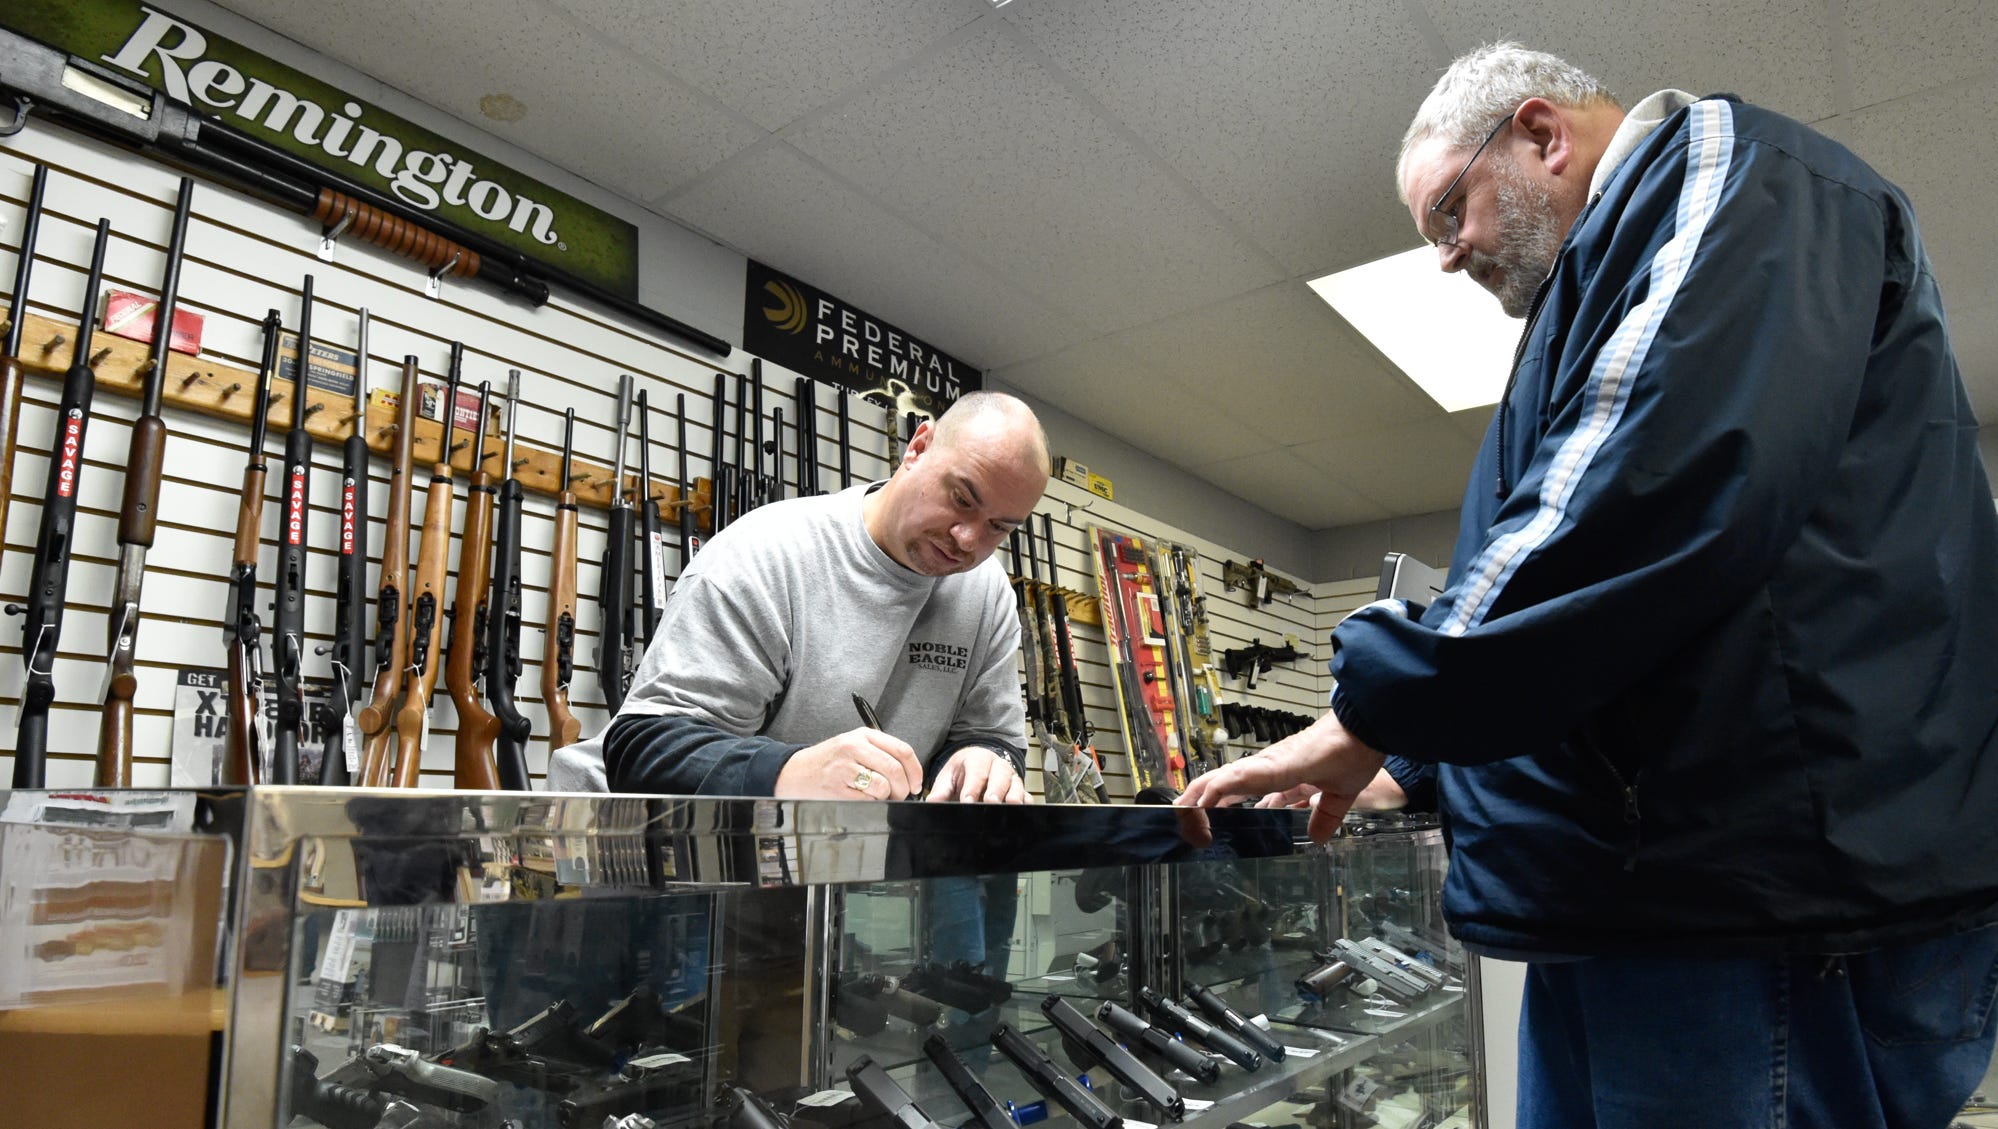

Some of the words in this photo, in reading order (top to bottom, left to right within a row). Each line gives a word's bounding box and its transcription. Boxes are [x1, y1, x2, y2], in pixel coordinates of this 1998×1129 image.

[100, 6, 558, 244] Remington
[816, 323, 961, 400] PREMIUM
[818, 298, 960, 383] FEDERAL
[814, 350, 946, 412] AMMUNON
[61, 424, 79, 492] SAVAGE
[290, 480, 303, 540] SAVAGE
[343, 492, 354, 550] SAVAGE
[187, 672, 217, 687] GET
[909, 642, 968, 657] NOBLE
[909, 654, 967, 669] EAGLE
